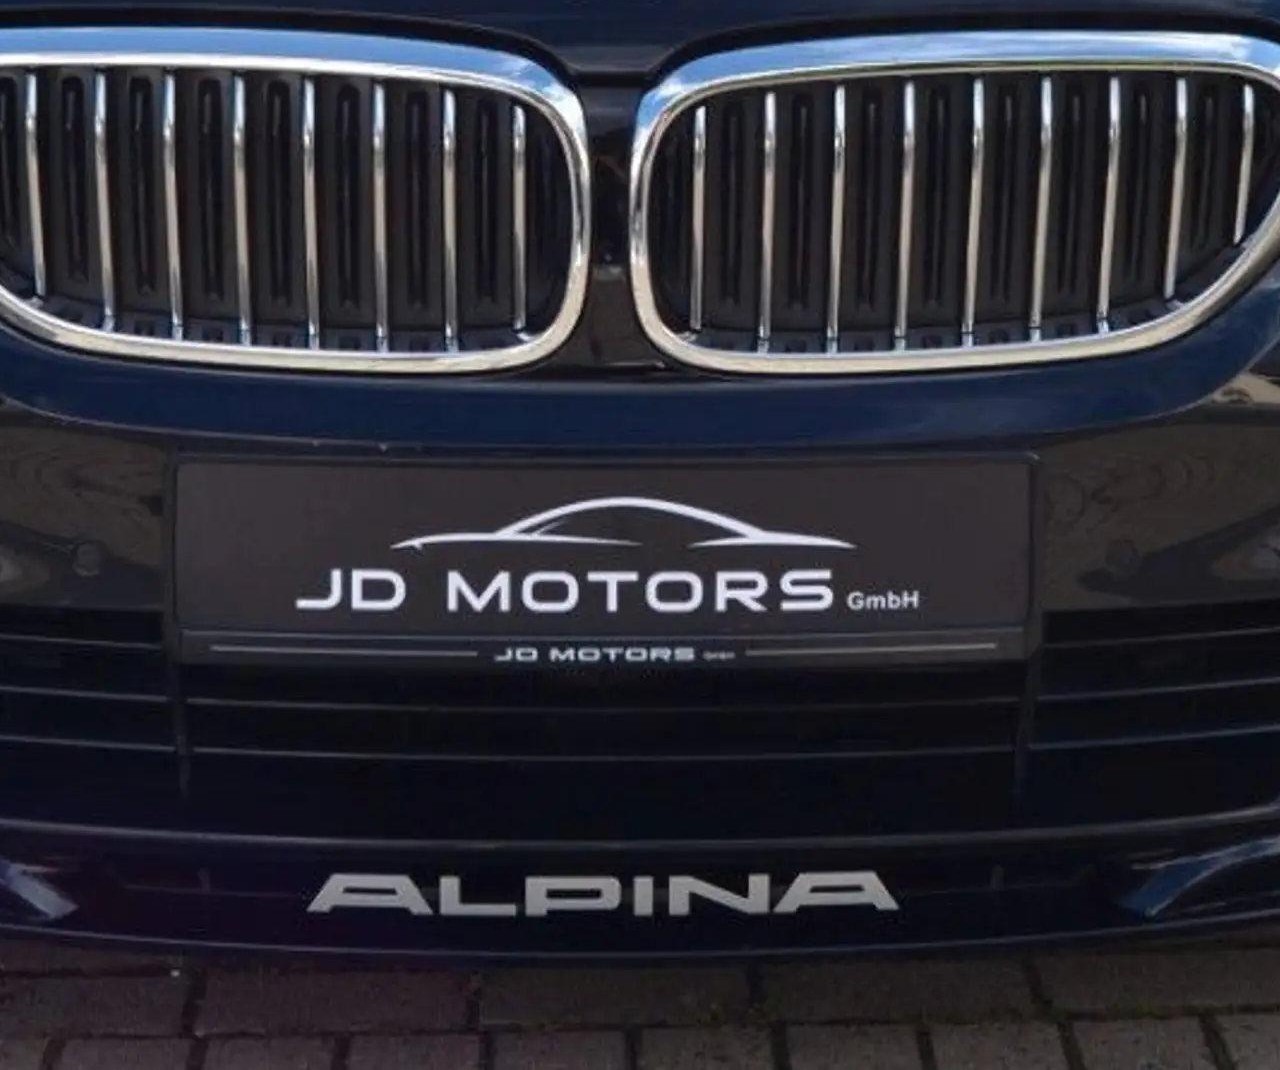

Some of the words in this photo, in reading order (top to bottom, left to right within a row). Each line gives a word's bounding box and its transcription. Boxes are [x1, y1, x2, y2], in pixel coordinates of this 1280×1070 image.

[296, 569, 405, 610] JD
[448, 570, 833, 612] MOTORS
[847, 591, 919, 610] GmbH
[550, 648, 694, 661] MOTORS
[307, 871, 898, 916] ALPINA
